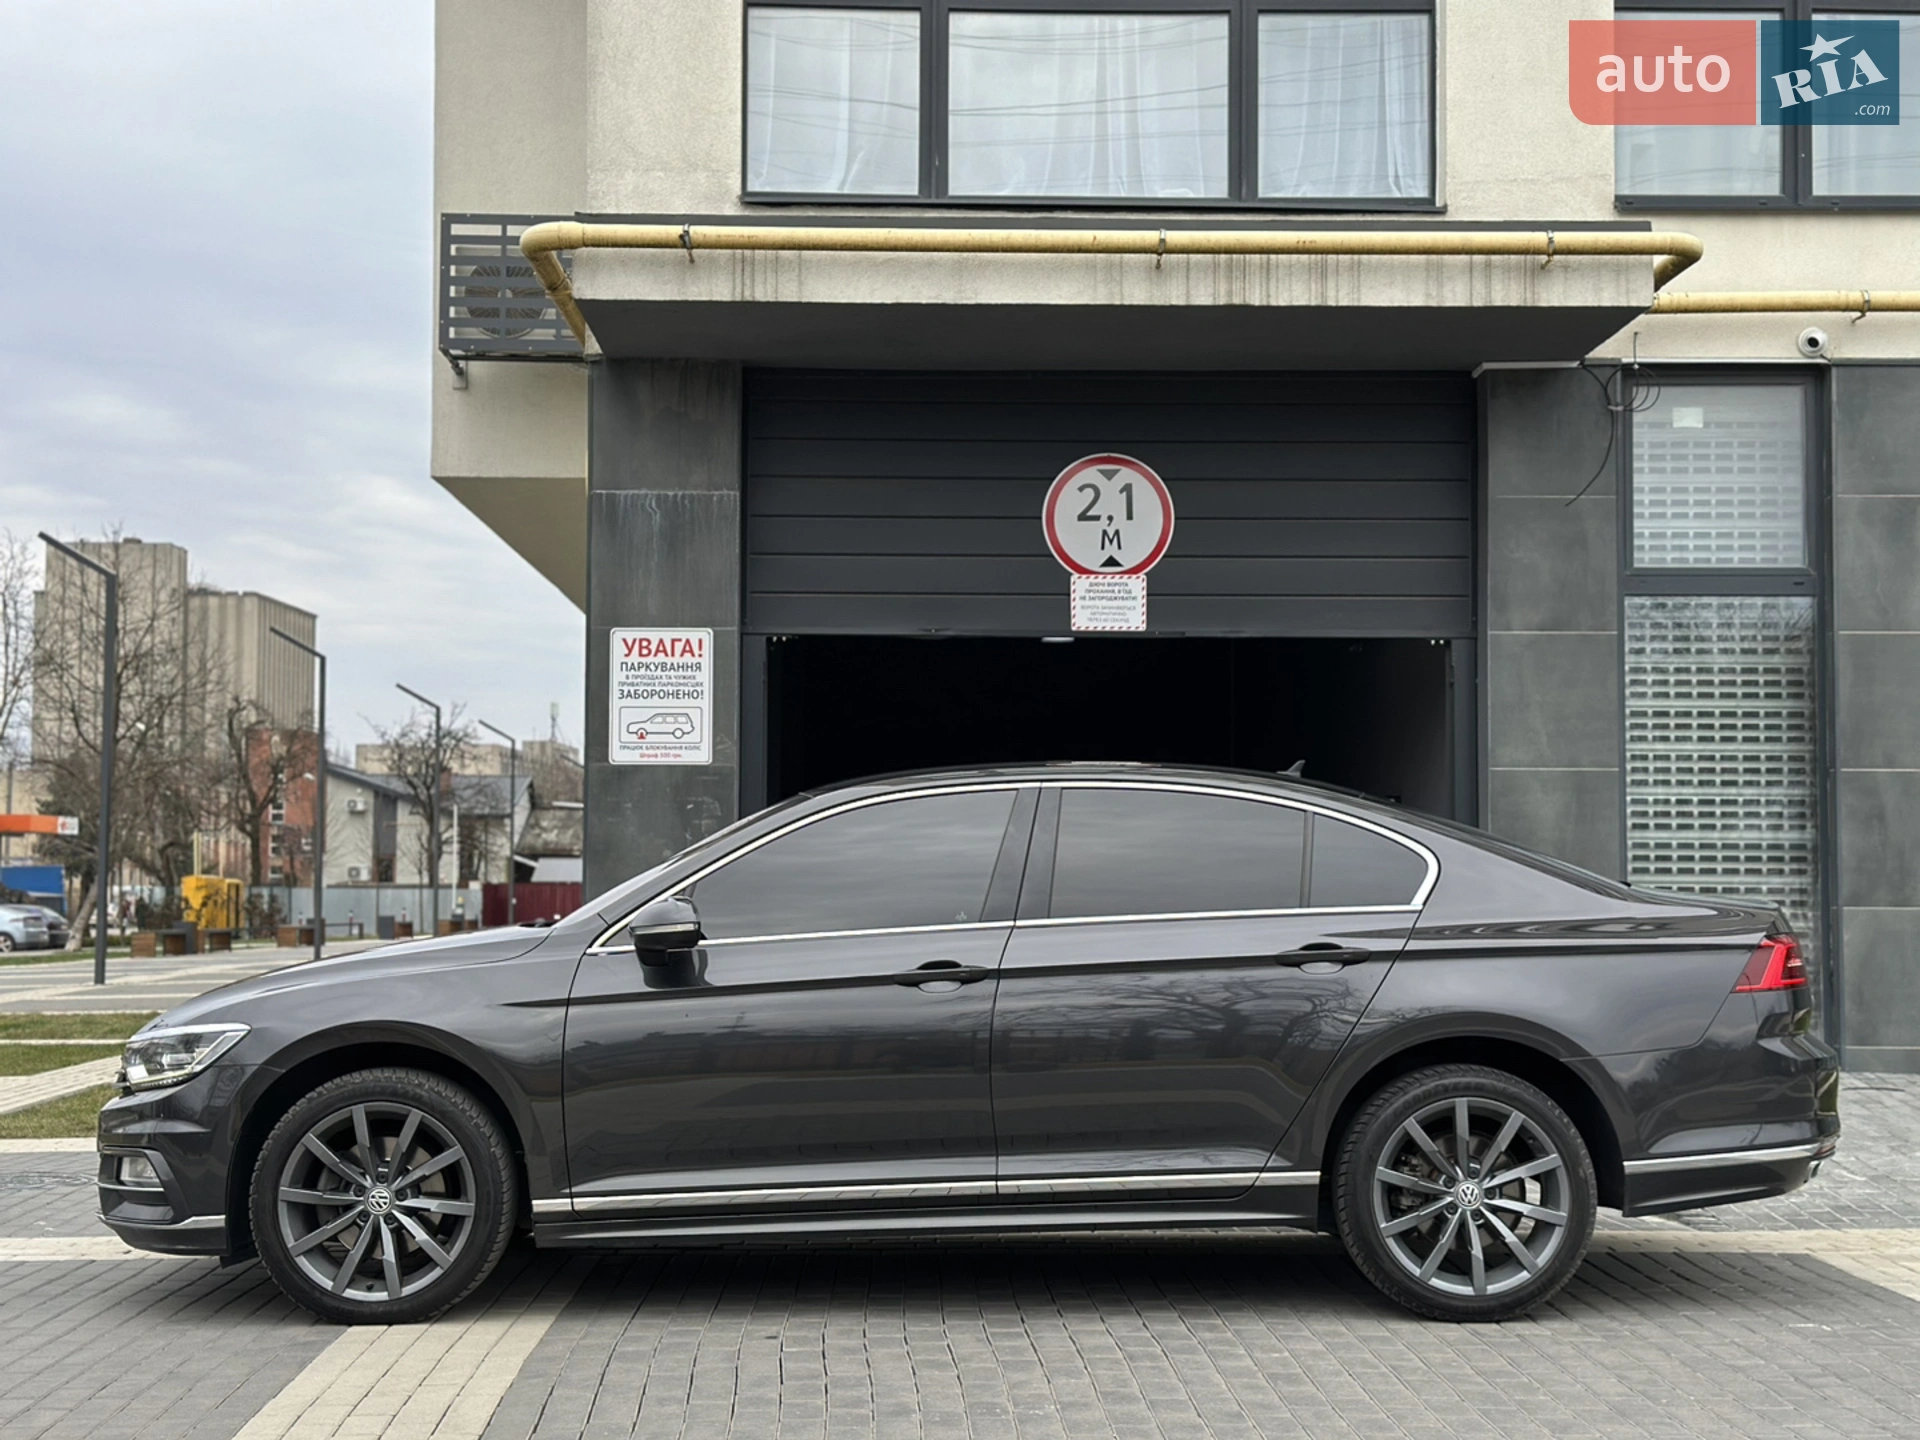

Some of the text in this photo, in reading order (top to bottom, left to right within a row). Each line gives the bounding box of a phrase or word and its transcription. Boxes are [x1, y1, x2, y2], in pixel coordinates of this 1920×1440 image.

[1077, 483, 1134, 526] 2,1
[622, 637, 703, 658] УВАГА!
[620, 661, 702, 673] ПАРКУВАННЯ
[618, 688, 704, 700] ЗАБОРОНЕНО!
